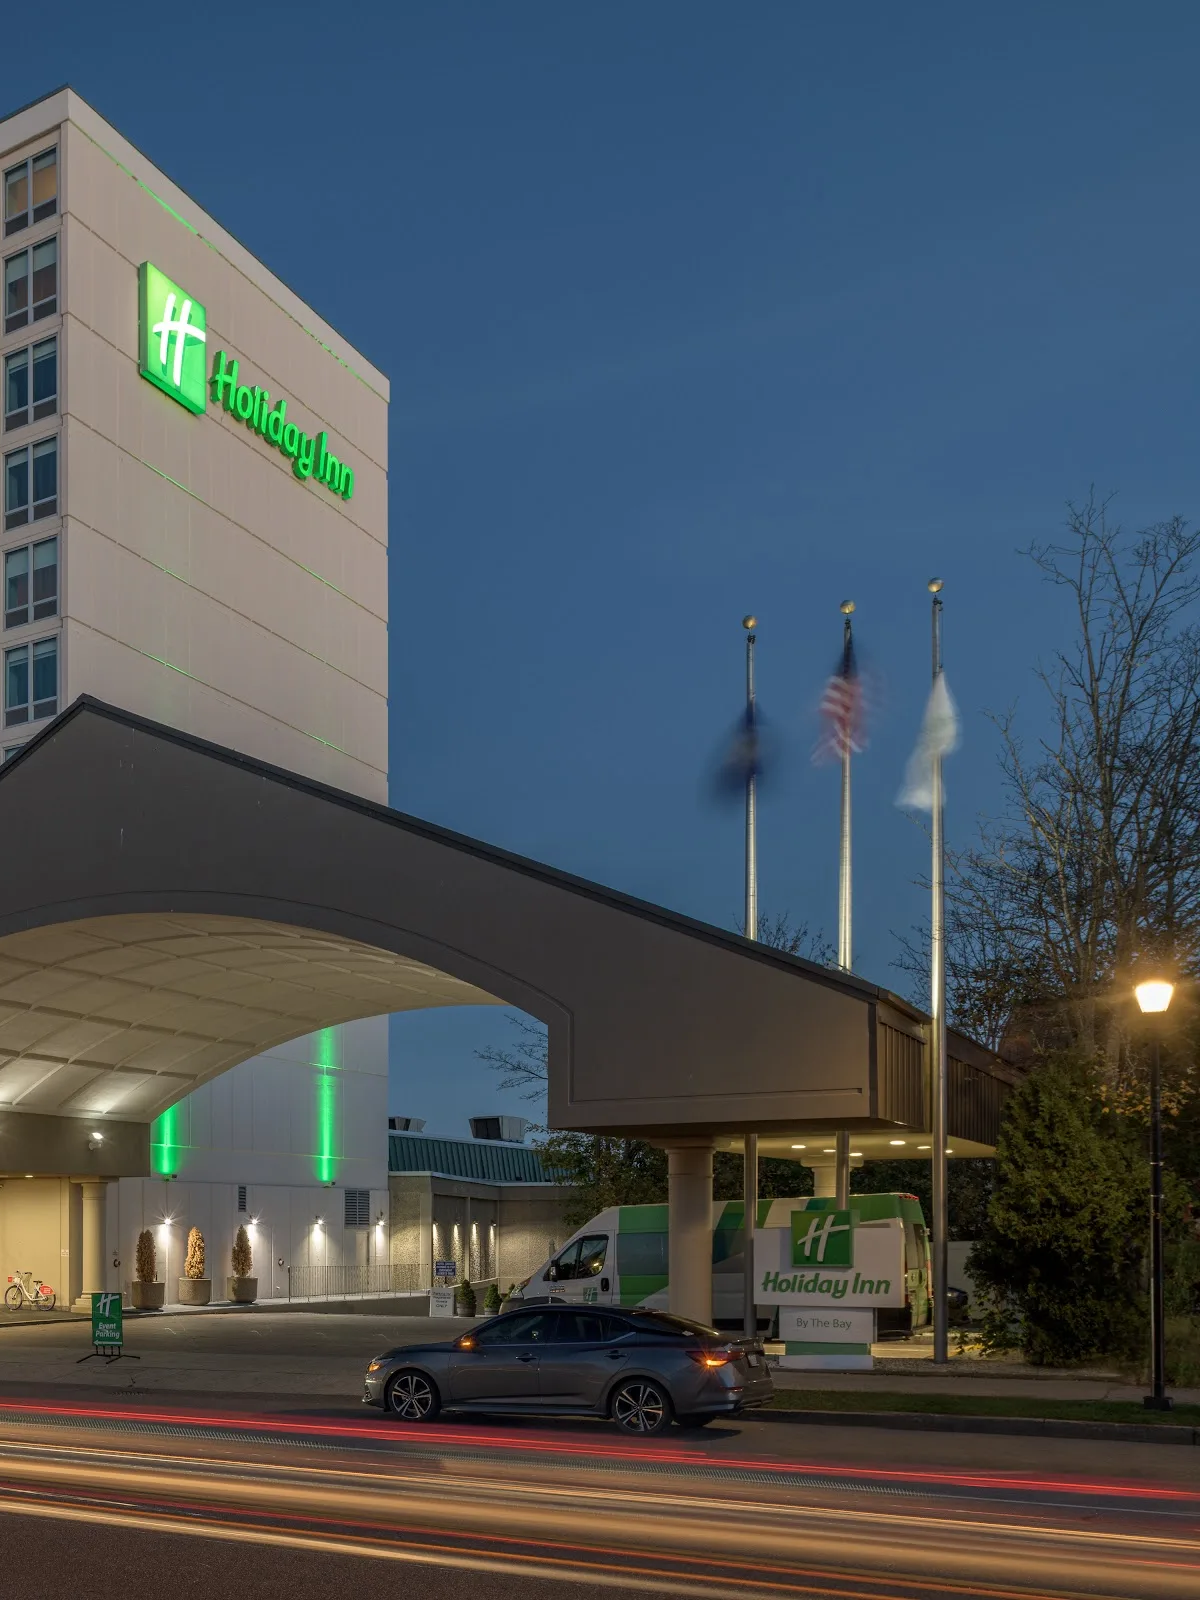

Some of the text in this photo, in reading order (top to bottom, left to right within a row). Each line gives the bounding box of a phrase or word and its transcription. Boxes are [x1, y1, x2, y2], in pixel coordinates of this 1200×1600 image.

[209, 350, 355, 501] Holiday Inn
[761, 1271, 891, 1299] Holiday Inn
[98, 1322, 117, 1330] Event
[796, 1317, 852, 1330] By The Bay
[95, 1330, 120, 1339] Parking
